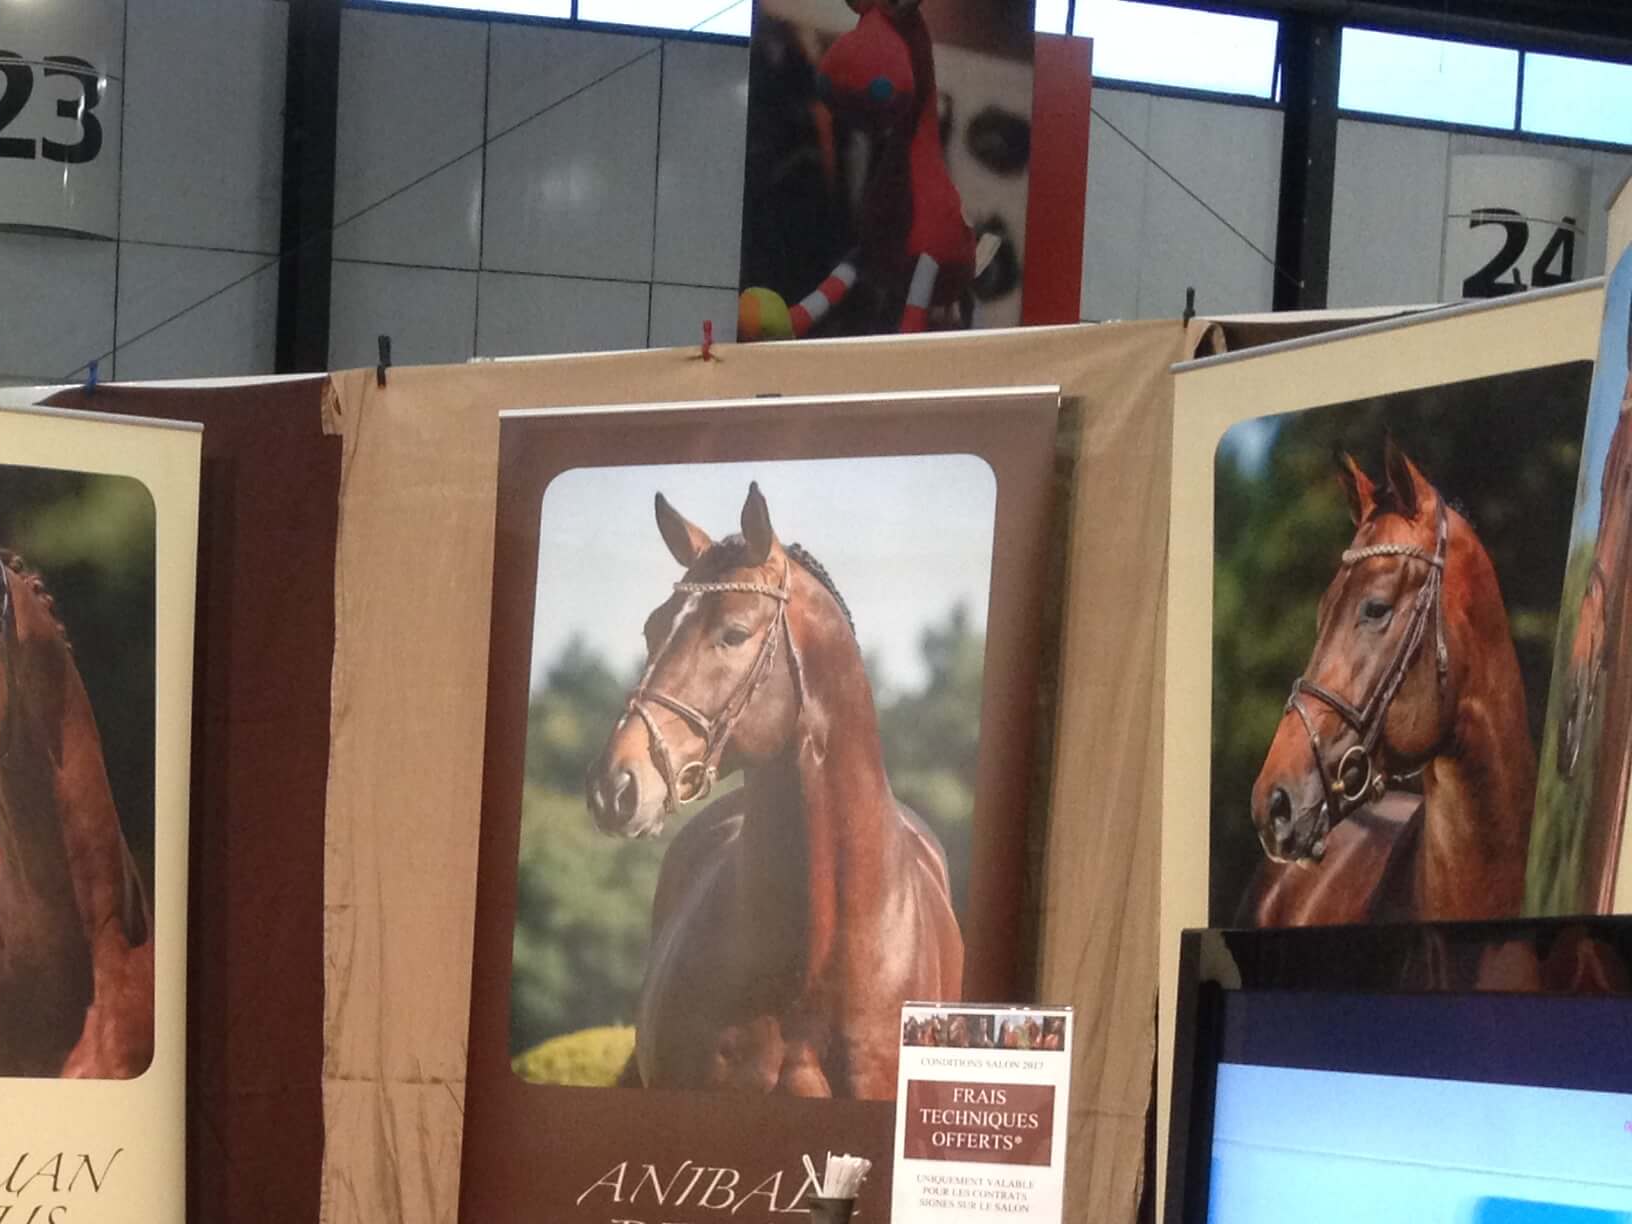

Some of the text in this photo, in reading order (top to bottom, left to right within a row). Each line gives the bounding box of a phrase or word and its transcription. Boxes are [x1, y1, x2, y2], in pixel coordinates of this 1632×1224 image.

[1462, 208, 1576, 298] 24
[953, 1087, 1007, 1105] FRAIS
[920, 1108, 1039, 1130] TECHNIQUES
[576, 1160, 867, 1216] ANIBAL
